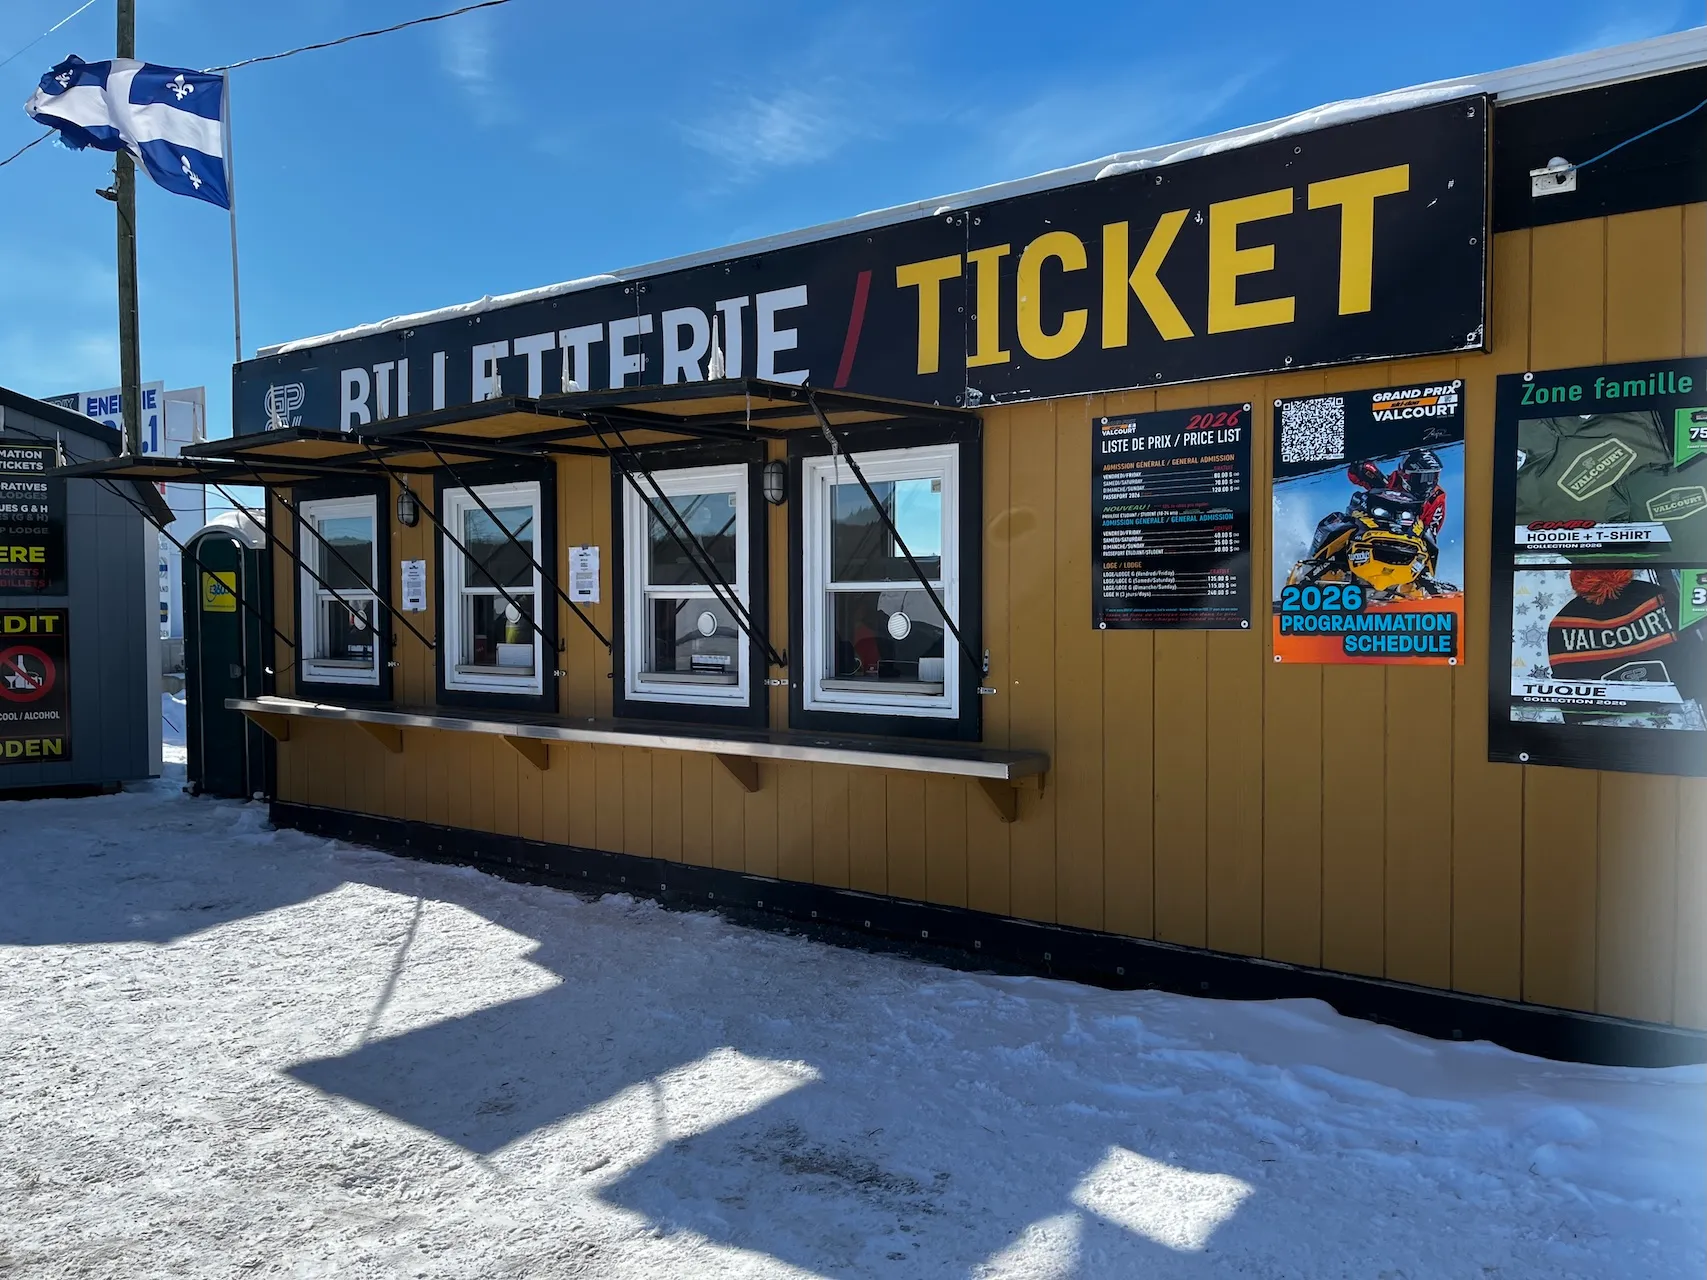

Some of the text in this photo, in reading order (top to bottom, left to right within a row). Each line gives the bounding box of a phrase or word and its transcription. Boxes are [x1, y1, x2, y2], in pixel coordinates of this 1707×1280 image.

[895, 163, 1411, 376] TICKET
[1372, 386, 1456, 402] GRAND PRIX
[1521, 371, 1693, 406] Zone famille
[87, 389, 157, 416] ENEIE
[1186, 410, 1242, 430] 2026
[1372, 404, 1458, 422] VALCOURT
[1102, 427, 1137, 436] VALCOURT
[1102, 428, 1241, 454] LISTE DE PRIX / PRICE LIST
[1103, 463, 1134, 471] ADMISSION
[1172, 457, 1199, 465] GENERAL
[1200, 454, 1235, 463] ADMISSION
[1570, 448, 1624, 491] VALCOURT
[1, 482, 48, 491] RATIVES
[0, 492, 48, 500] LODGES
[1653, 496, 1703, 513] VALCOURT
[1199, 513, 1234, 521] ADMISSION
[1528, 520, 1596, 531] COMBO
[1527, 532, 1580, 542] HOODIE
[1596, 530, 1651, 540] T-SHIRT
[1281, 585, 1362, 612] 2026
[0, 616, 59, 633] DIT
[1281, 614, 1452, 633] PROGRAMMATION
[1562, 607, 1673, 651] VALCOURT
[1344, 634, 1452, 653] SCHEDULE
[1523, 684, 1607, 697] TUQUE
[1523, 697, 1594, 705] COLLECTION
[24, 711, 60, 720] ALCOHOL
[0, 738, 62, 757] DEN
